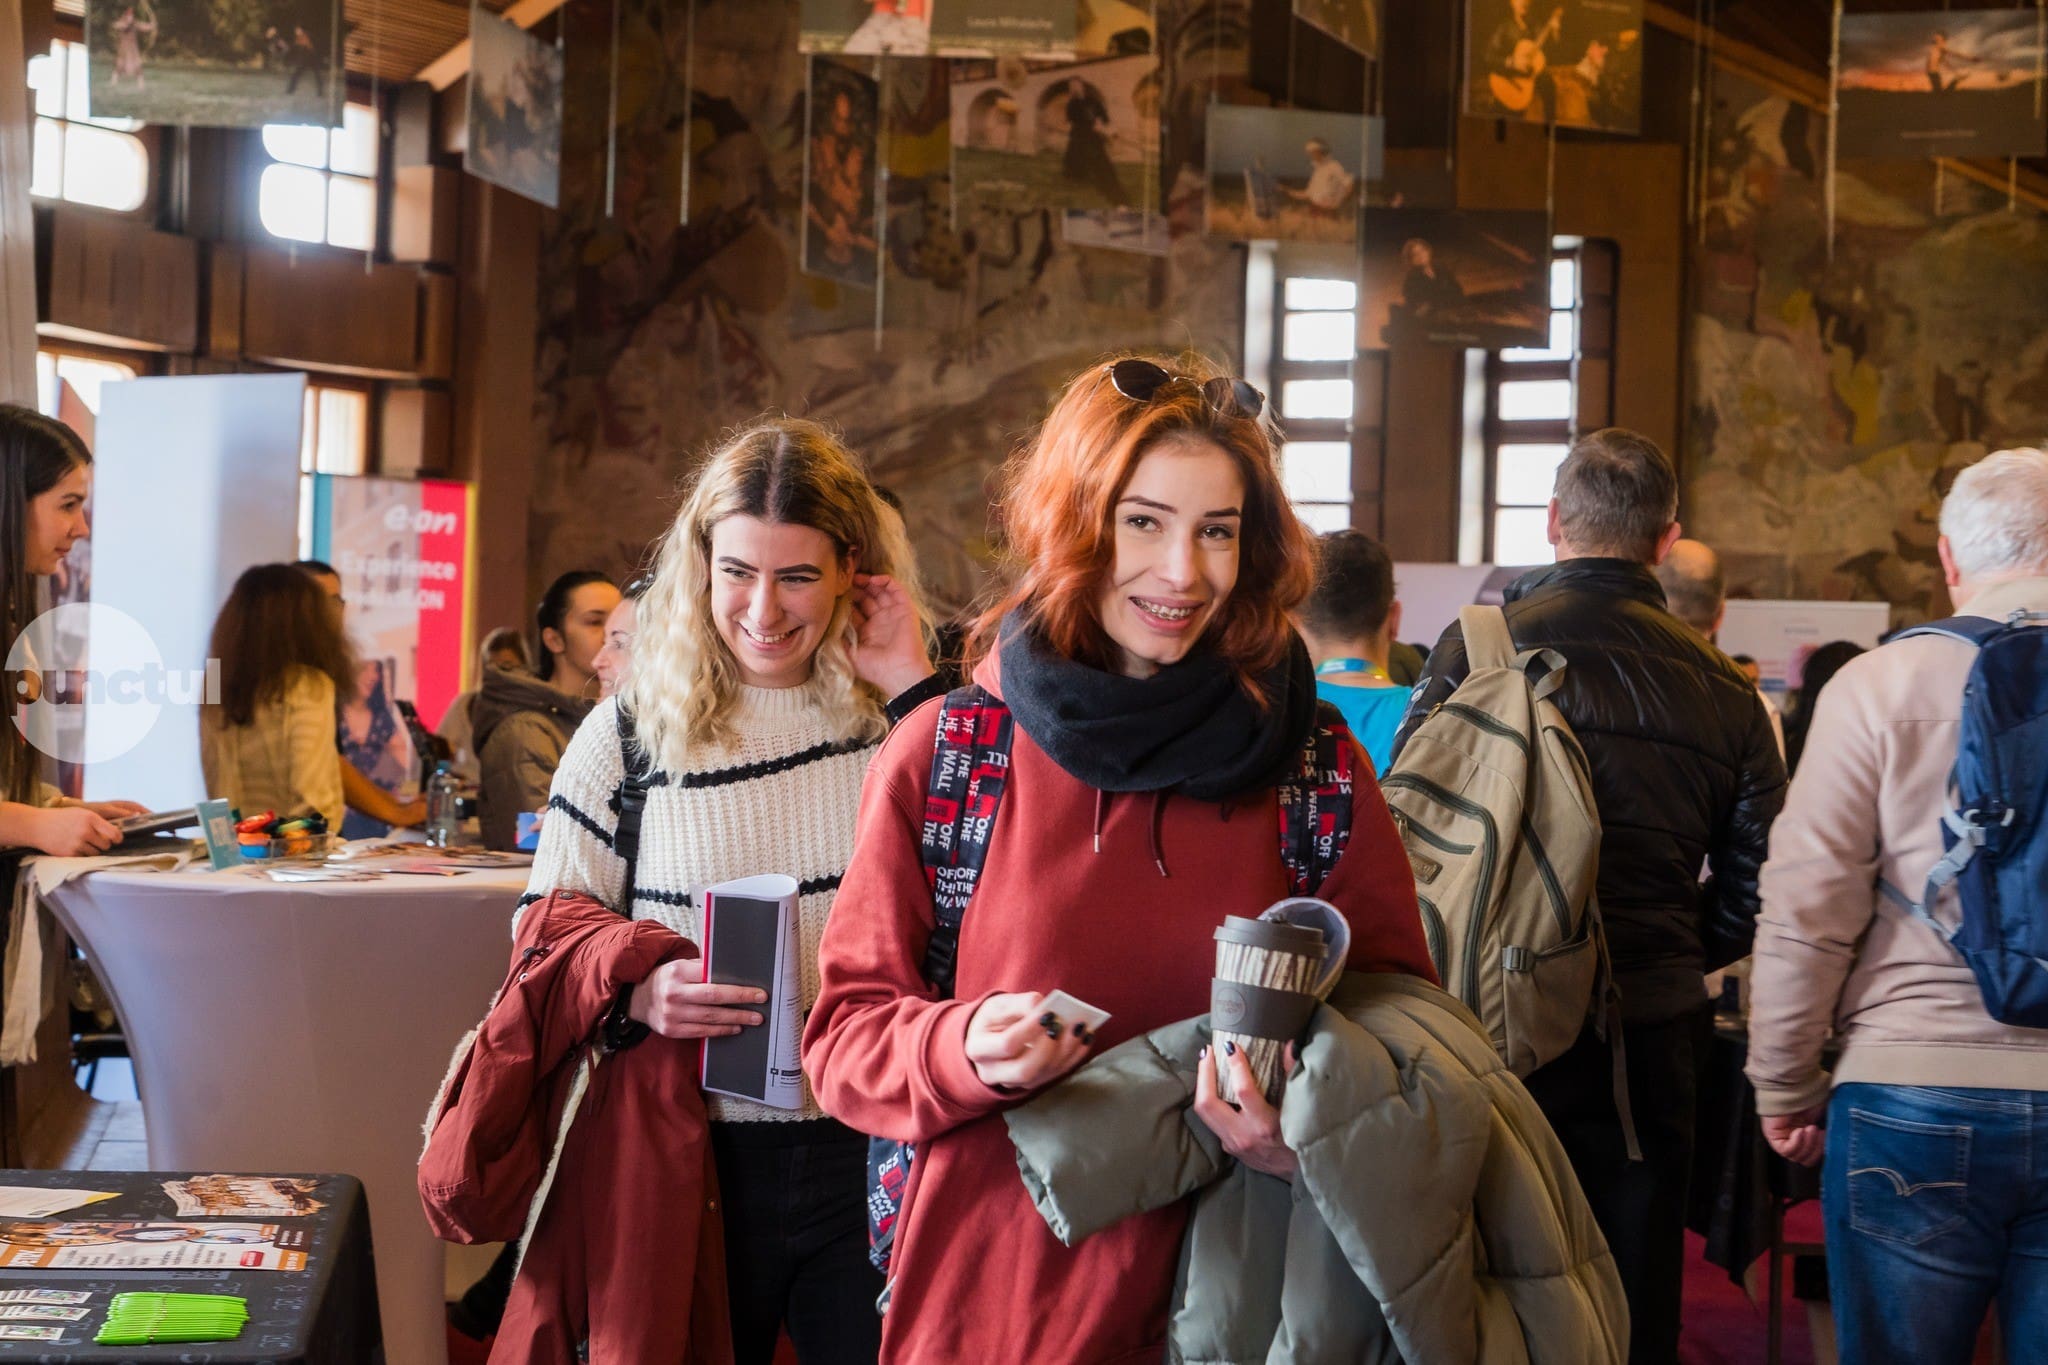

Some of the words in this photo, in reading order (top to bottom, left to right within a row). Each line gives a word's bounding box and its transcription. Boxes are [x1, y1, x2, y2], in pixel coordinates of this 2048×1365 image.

[922, 821, 937, 847] THE
[960, 816, 975, 842] THE
[957, 866, 977, 881] OFF
